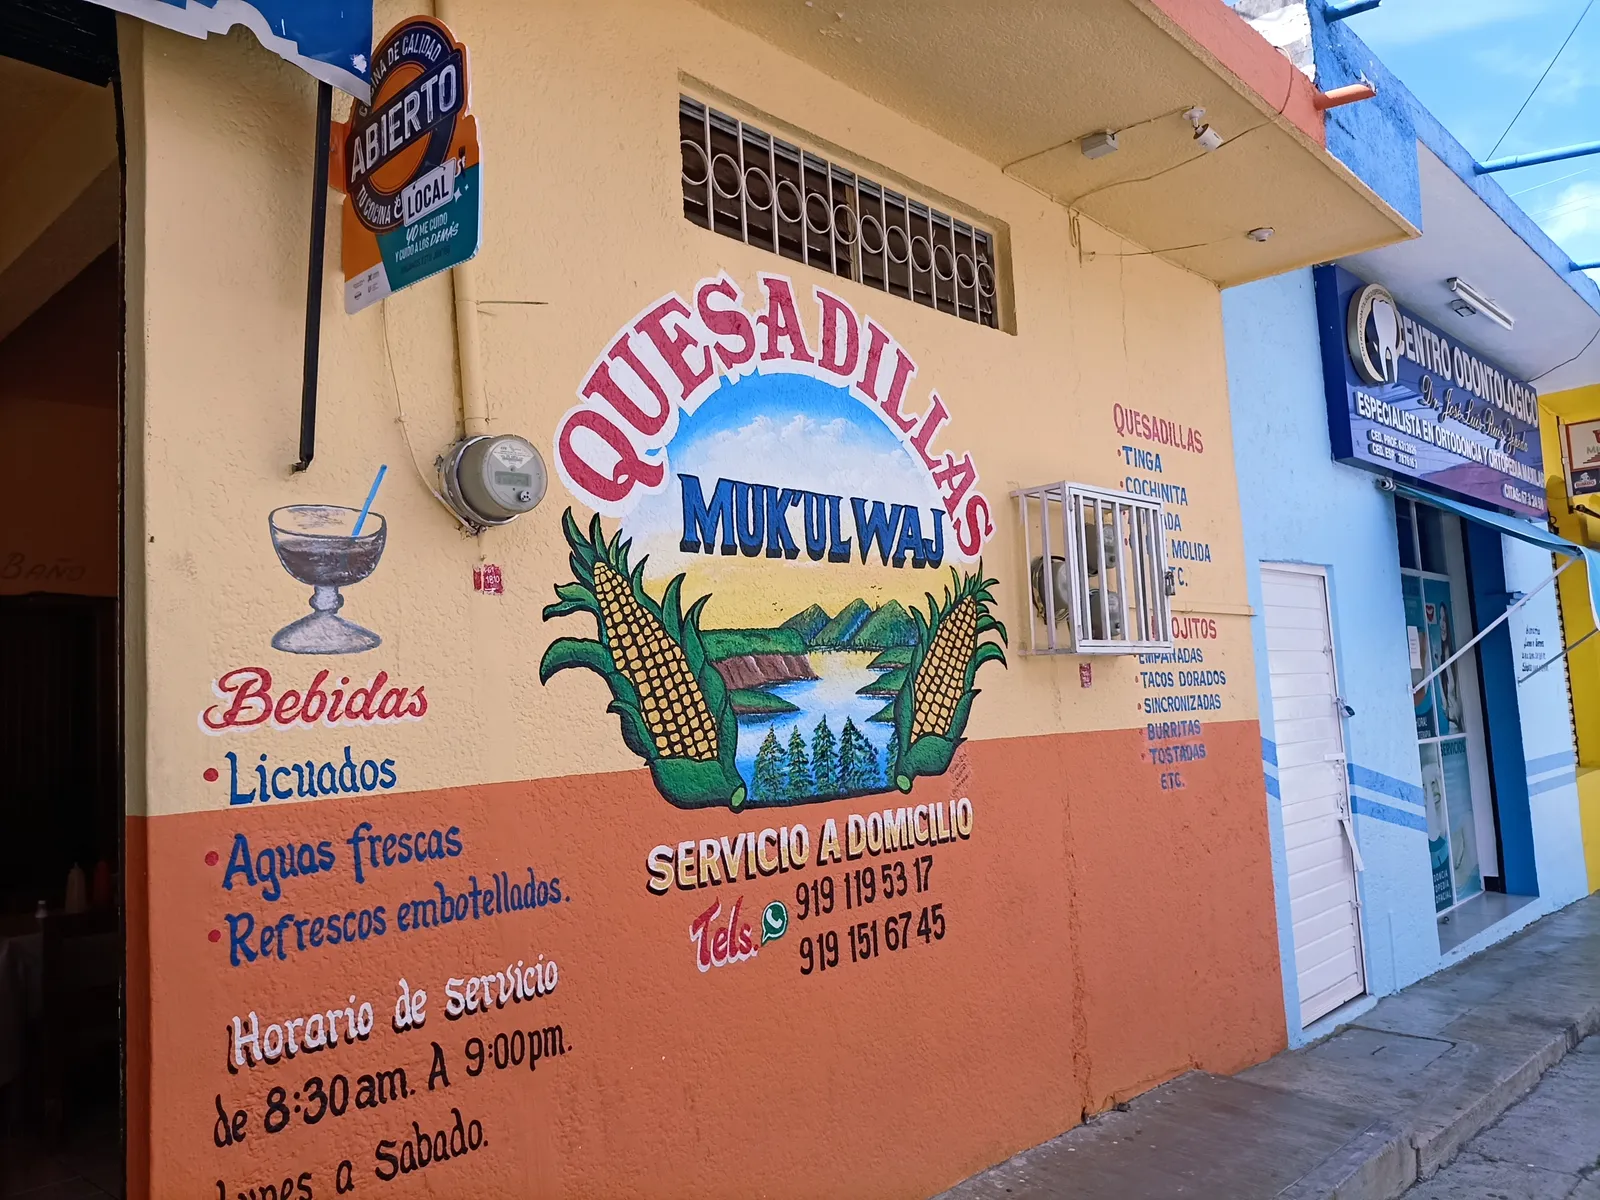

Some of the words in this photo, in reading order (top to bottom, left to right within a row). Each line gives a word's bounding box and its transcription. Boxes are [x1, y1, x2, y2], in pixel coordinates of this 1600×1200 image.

[387, 41, 400, 66] DE
[402, 33, 442, 62] CALIDAD
[351, 64, 457, 183] ABIERTO
[356, 184, 366, 207] TU
[363, 199, 391, 224] COCINA
[407, 174, 449, 219] LOCAL
[395, 251, 400, 263] Y
[399, 244, 414, 261] CUIDO
[414, 242, 419, 254] A
[419, 237, 430, 252] LOS
[430, 221, 459, 247] DEMÁS
[406, 224, 418, 246] YO
[420, 221, 428, 236] ME
[430, 212, 448, 232] CUIDO
[1454, 346, 1539, 428] ODONTOLOGICO
[557, 275, 994, 558] QUESADILLAS
[1113, 403, 1204, 454] QUESADILLAS
[1357, 391, 1422, 438] ESPECIALISTA
[1422, 420, 1435, 443] EN
[1435, 425, 1482, 464] ORTODONCIA
[1482, 446, 1489, 466] Y
[1489, 449, 1522, 479] ORTOPEDIA
[1122, 445, 1162, 473] TINGA
[1125, 476, 1188, 506] COCHINITA
[1172, 538, 1211, 562] MOLIDA
[1138, 647, 1203, 664] EMPANADAS
[1140, 671, 1174, 689] TACOS
[1179, 670, 1226, 687] DORADOS
[201, 666, 429, 732] Bebidas
[1144, 693, 1222, 713] SINCRONIZADAS
[1147, 719, 1201, 741] BURRITAS
[1149, 743, 1206, 765] TOSTADAS
[225, 746, 397, 805] Licuados
[1161, 772, 1185, 790] ETC.
[222, 833, 336, 901] Aguas
[347, 822, 463, 883] frescas
[647, 824, 810, 895] SERVICIO
[816, 819, 842, 866] A
[846, 798, 974, 860] DOMICILIO
[796, 876, 834, 920] 919
[844, 866, 876, 910] 119
[882, 861, 905, 900] 53
[912, 855, 933, 893] 17
[225, 905, 387, 966] Refrescos
[397, 867, 571, 932] embotellados.
[689, 896, 759, 972] Tels.
[800, 930, 839, 975] 919
[848, 919, 879, 963] 151
[885, 911, 912, 952] 67
[917, 903, 946, 944] 45
[228, 995, 374, 1073] Horario
[393, 978, 427, 1033] de
[214, 1094, 248, 1148] de
[428, 1041, 450, 1090] A
[335, 1160, 355, 1194] a
